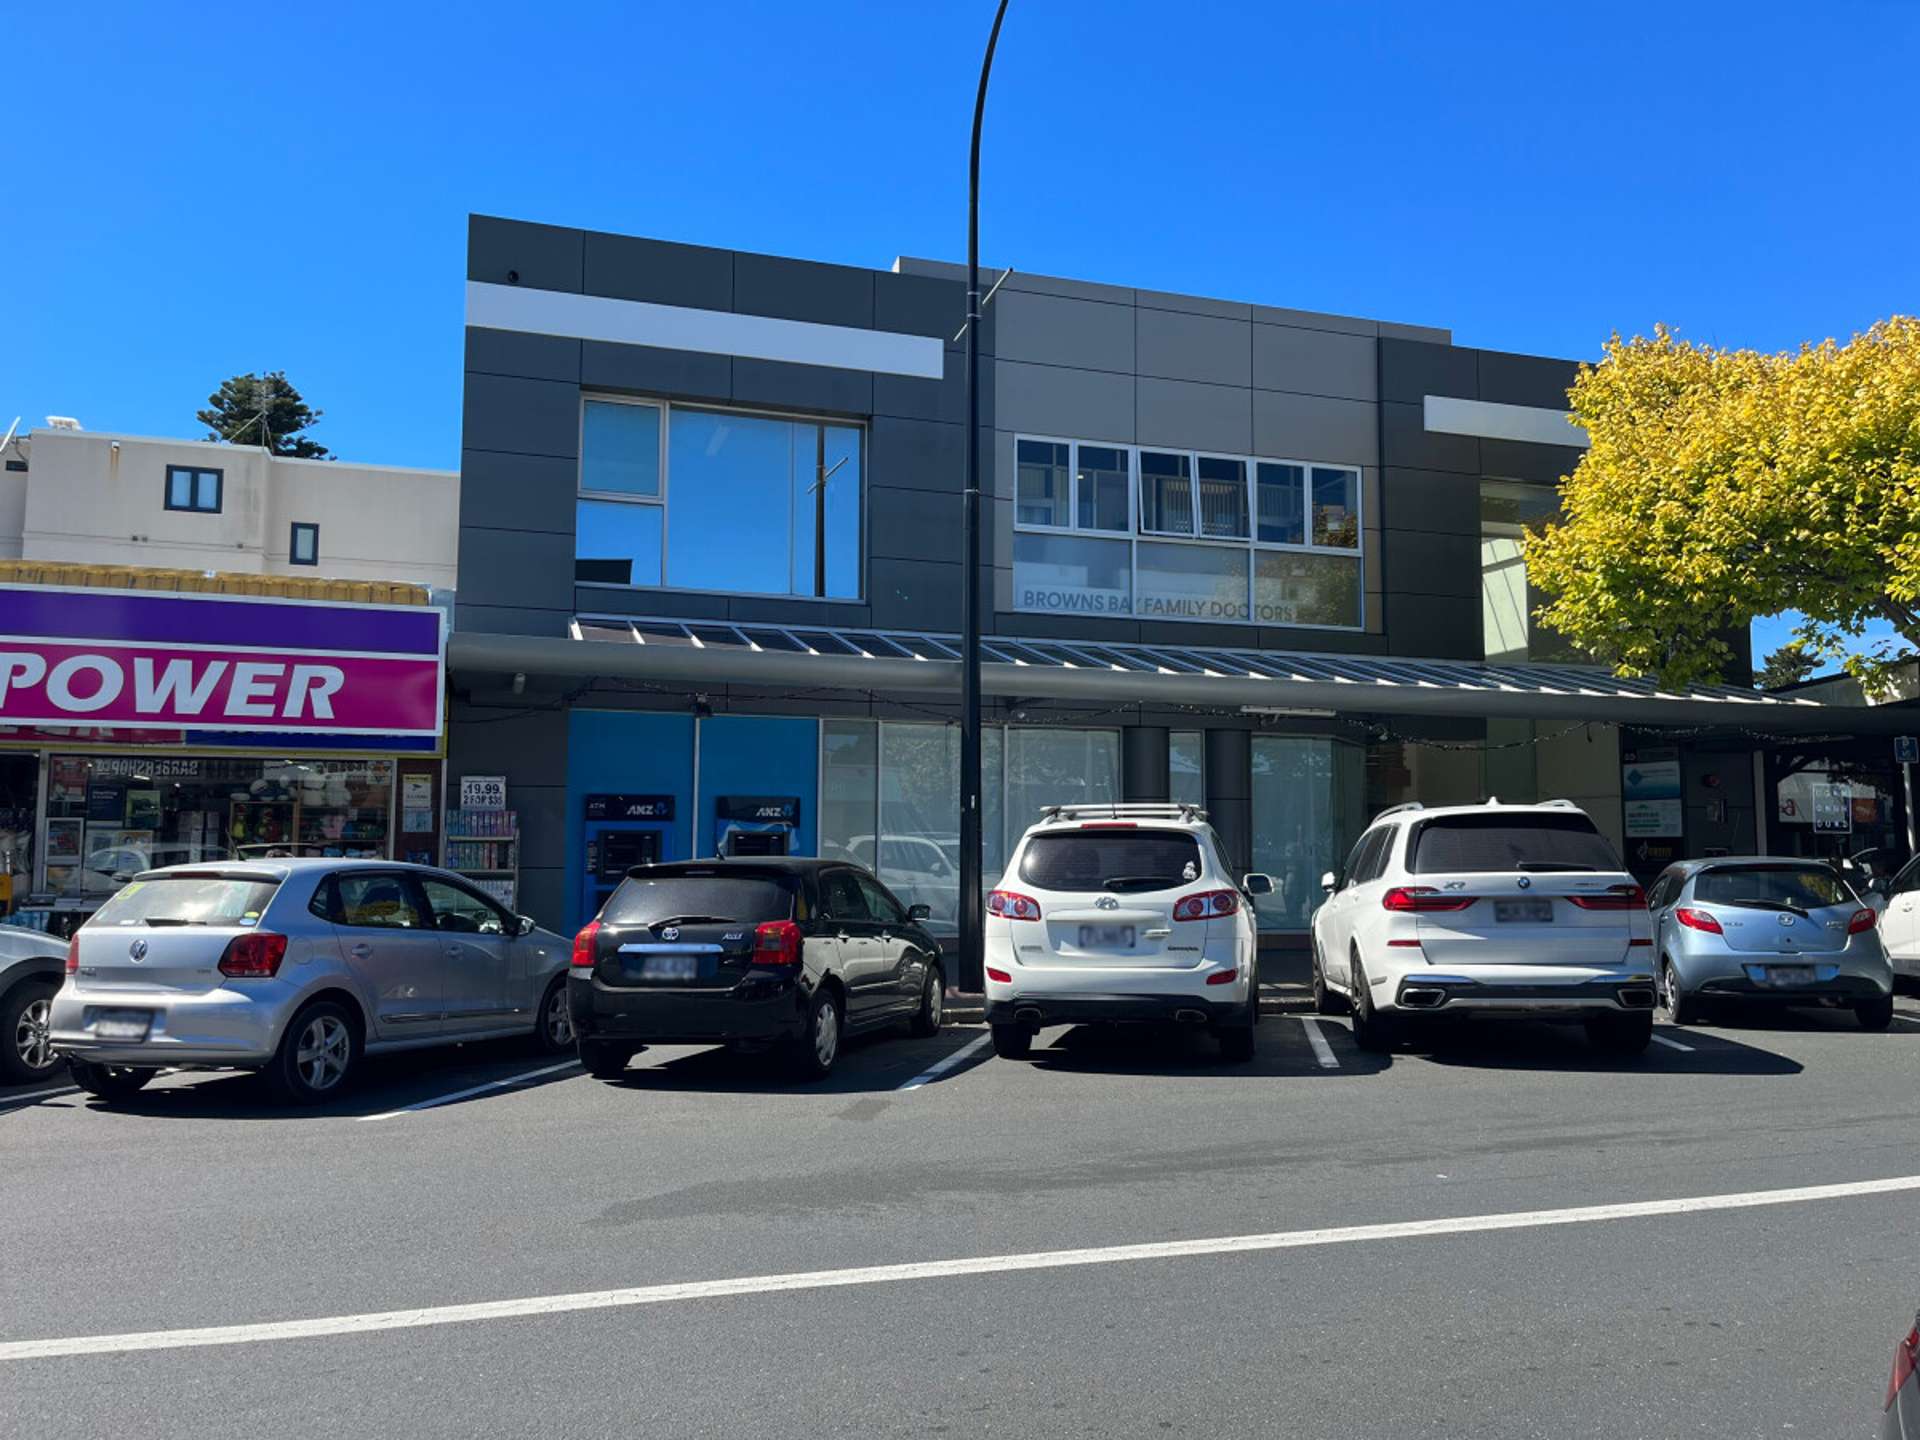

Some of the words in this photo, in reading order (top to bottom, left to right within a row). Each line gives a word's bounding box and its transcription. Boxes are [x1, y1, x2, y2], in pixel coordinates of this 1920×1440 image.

[1023, 589, 1104, 611] BROWNS
[1145, 597, 1206, 617] FAMILY
[0, 651, 345, 720] POWER
[626, 804, 654, 816] ANZ
[755, 807, 782, 817] ANZ
